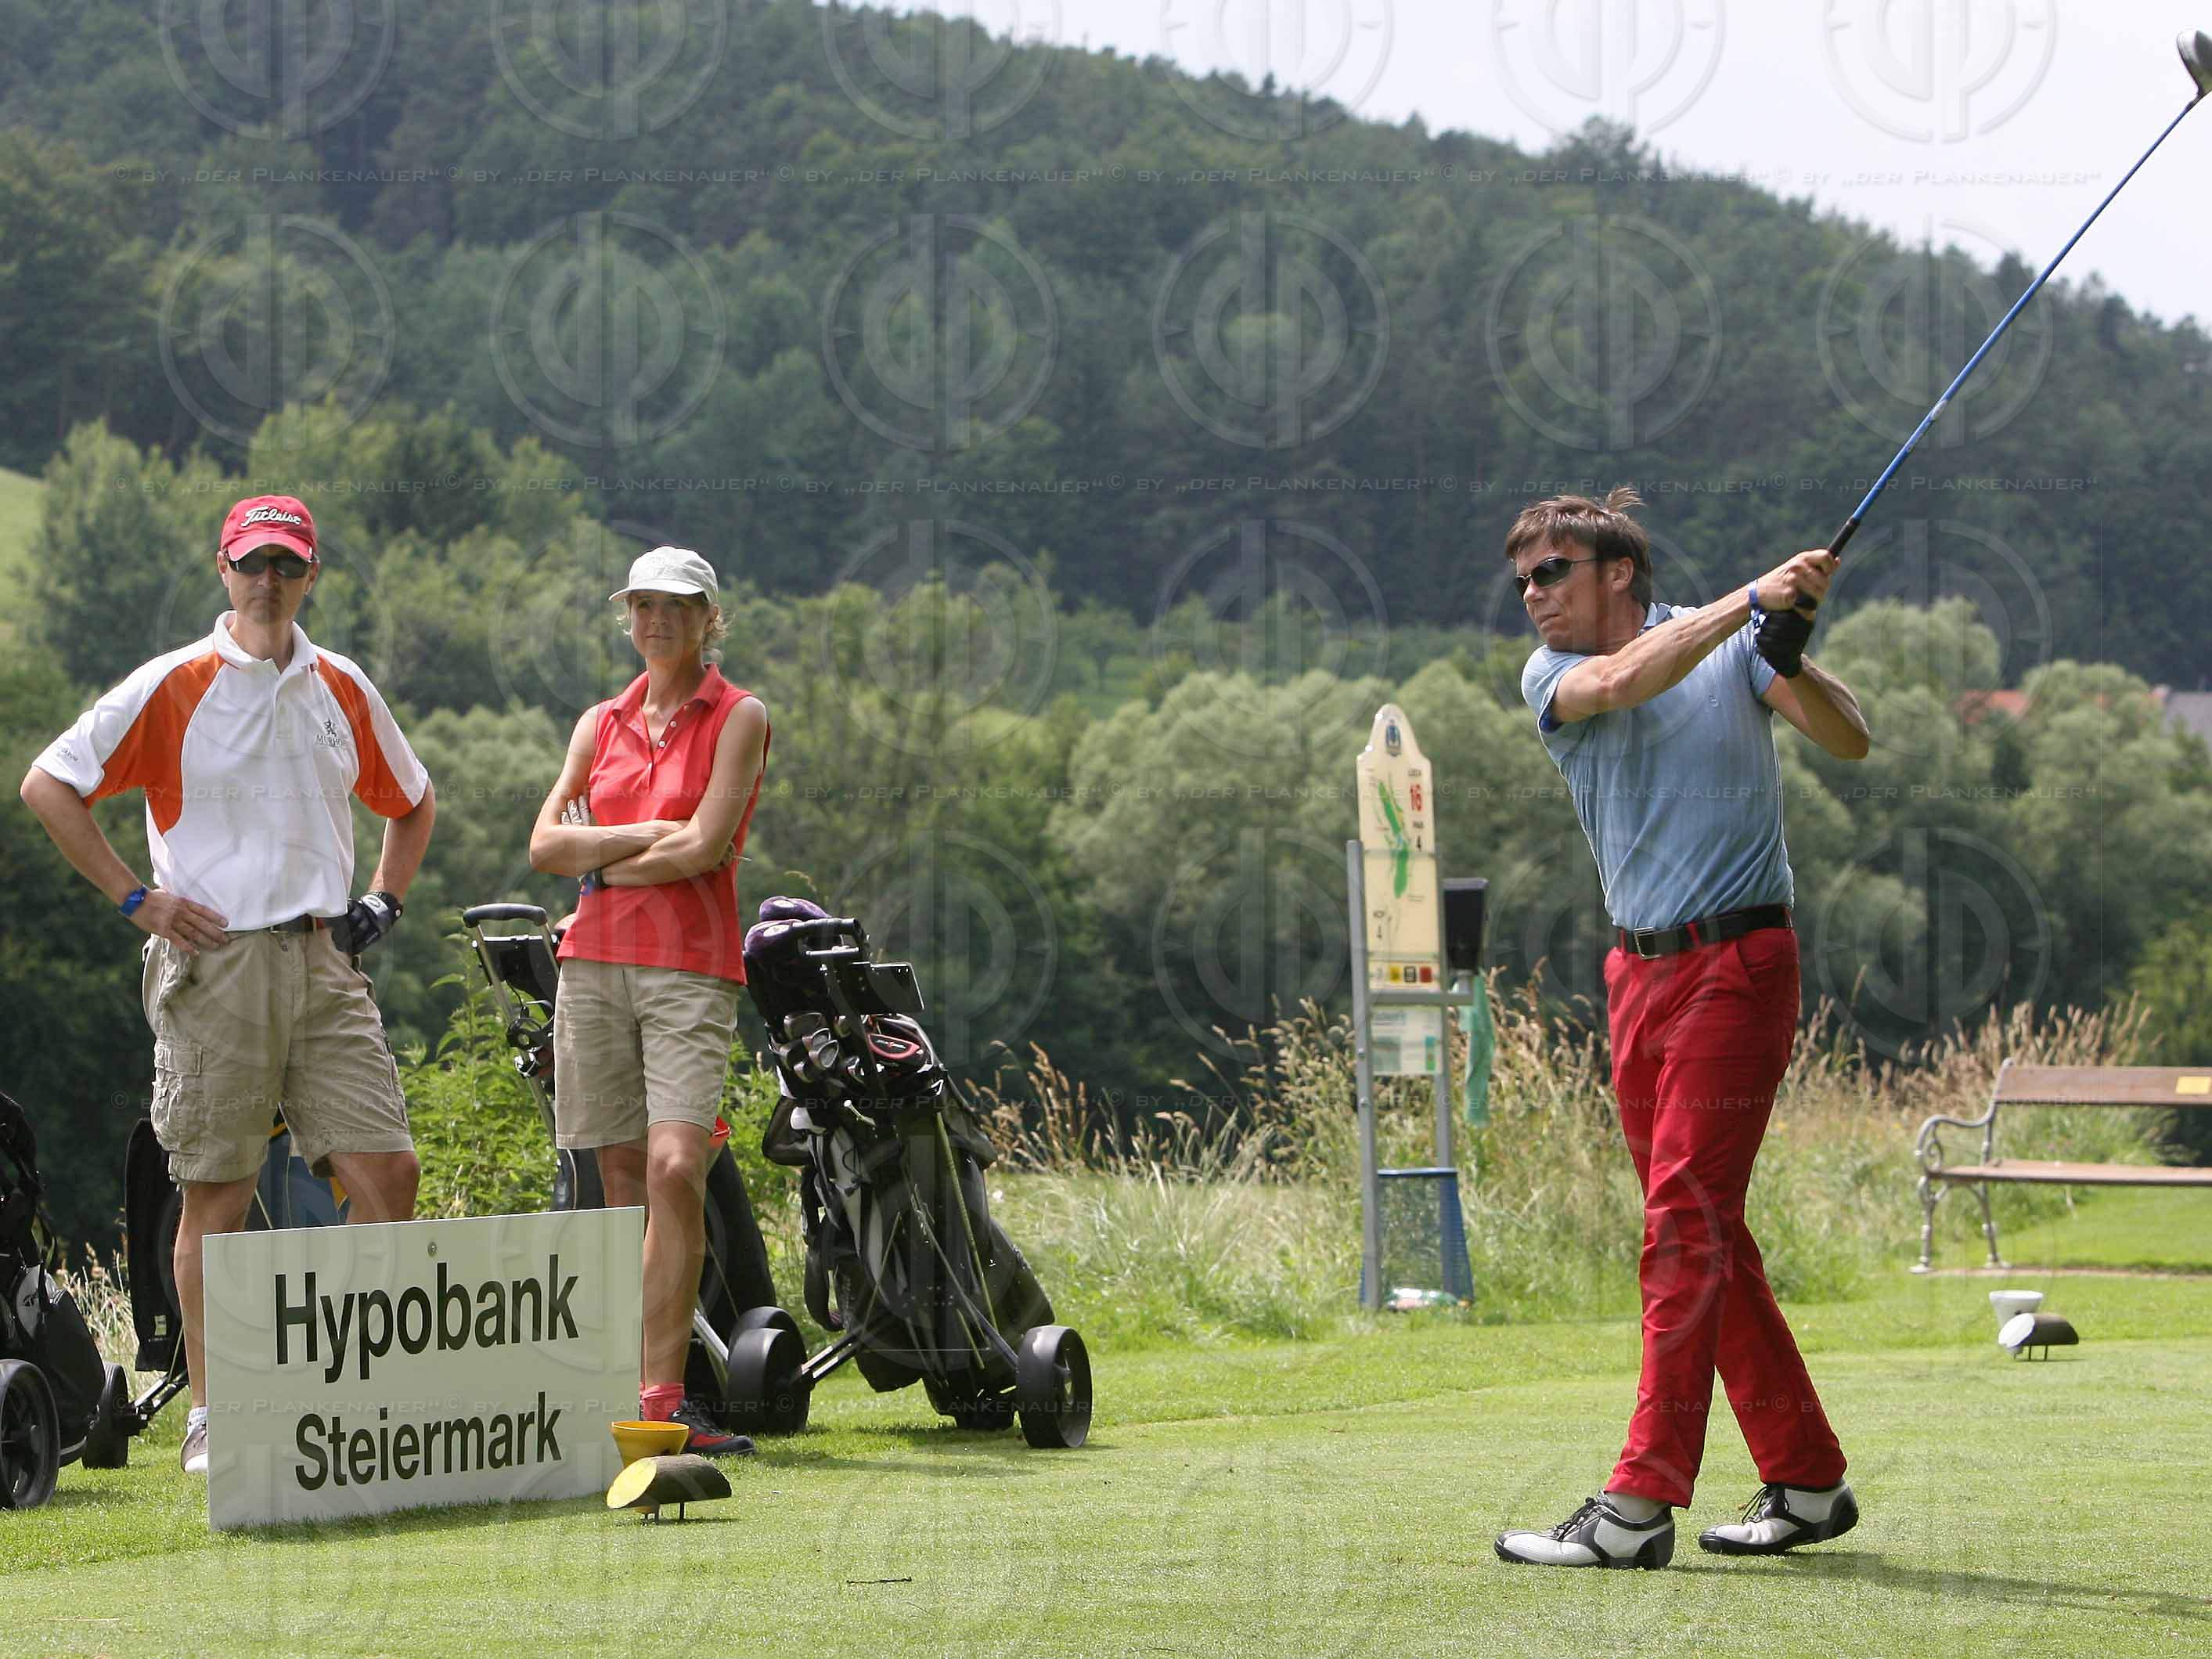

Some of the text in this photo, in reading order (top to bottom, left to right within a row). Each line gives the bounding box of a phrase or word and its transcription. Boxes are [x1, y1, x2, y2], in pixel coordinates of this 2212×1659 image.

[1410, 783, 1422, 811] 16
[275, 1254, 579, 1383] Hypobank
[295, 1391, 562, 1491] Steiermark
